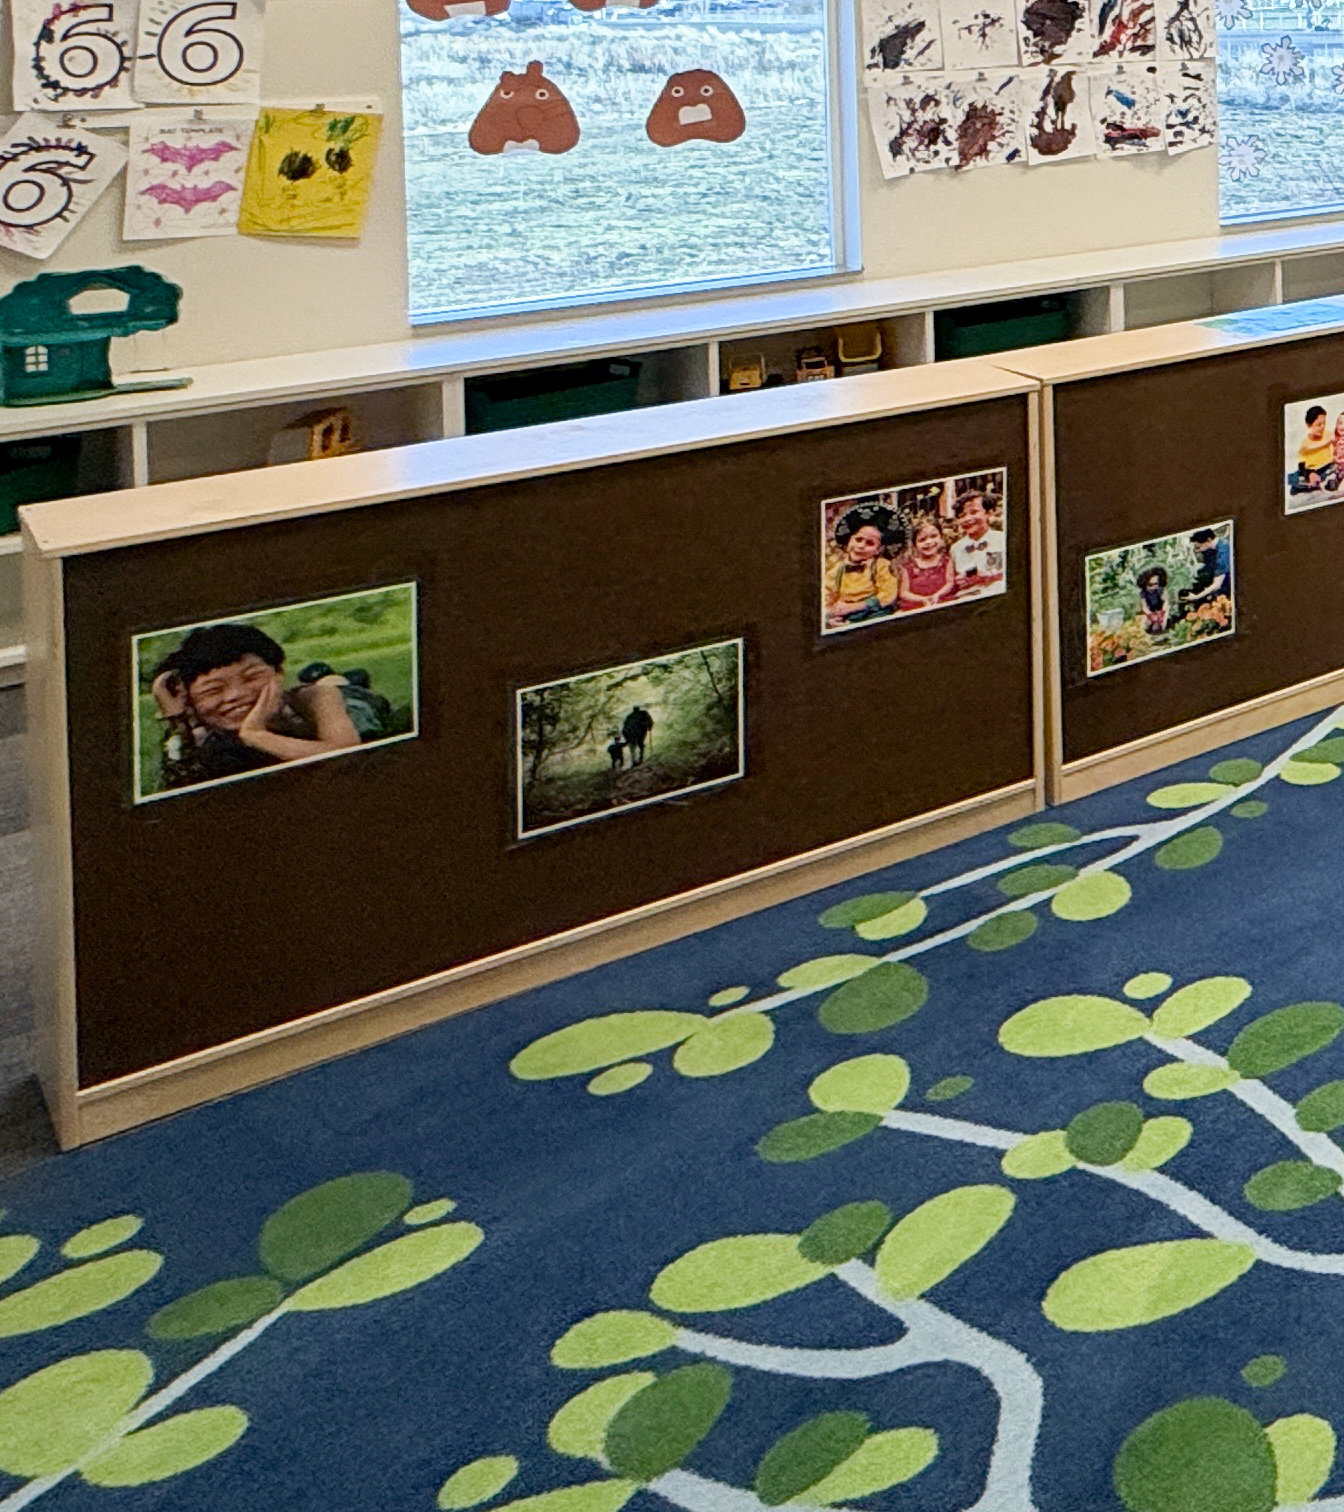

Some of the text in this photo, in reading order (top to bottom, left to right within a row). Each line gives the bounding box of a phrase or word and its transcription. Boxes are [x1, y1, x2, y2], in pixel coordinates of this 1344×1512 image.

[36, 3, 125, 92] 6
[157, 2, 244, 86] 6
[0, 144, 96, 229] 6
